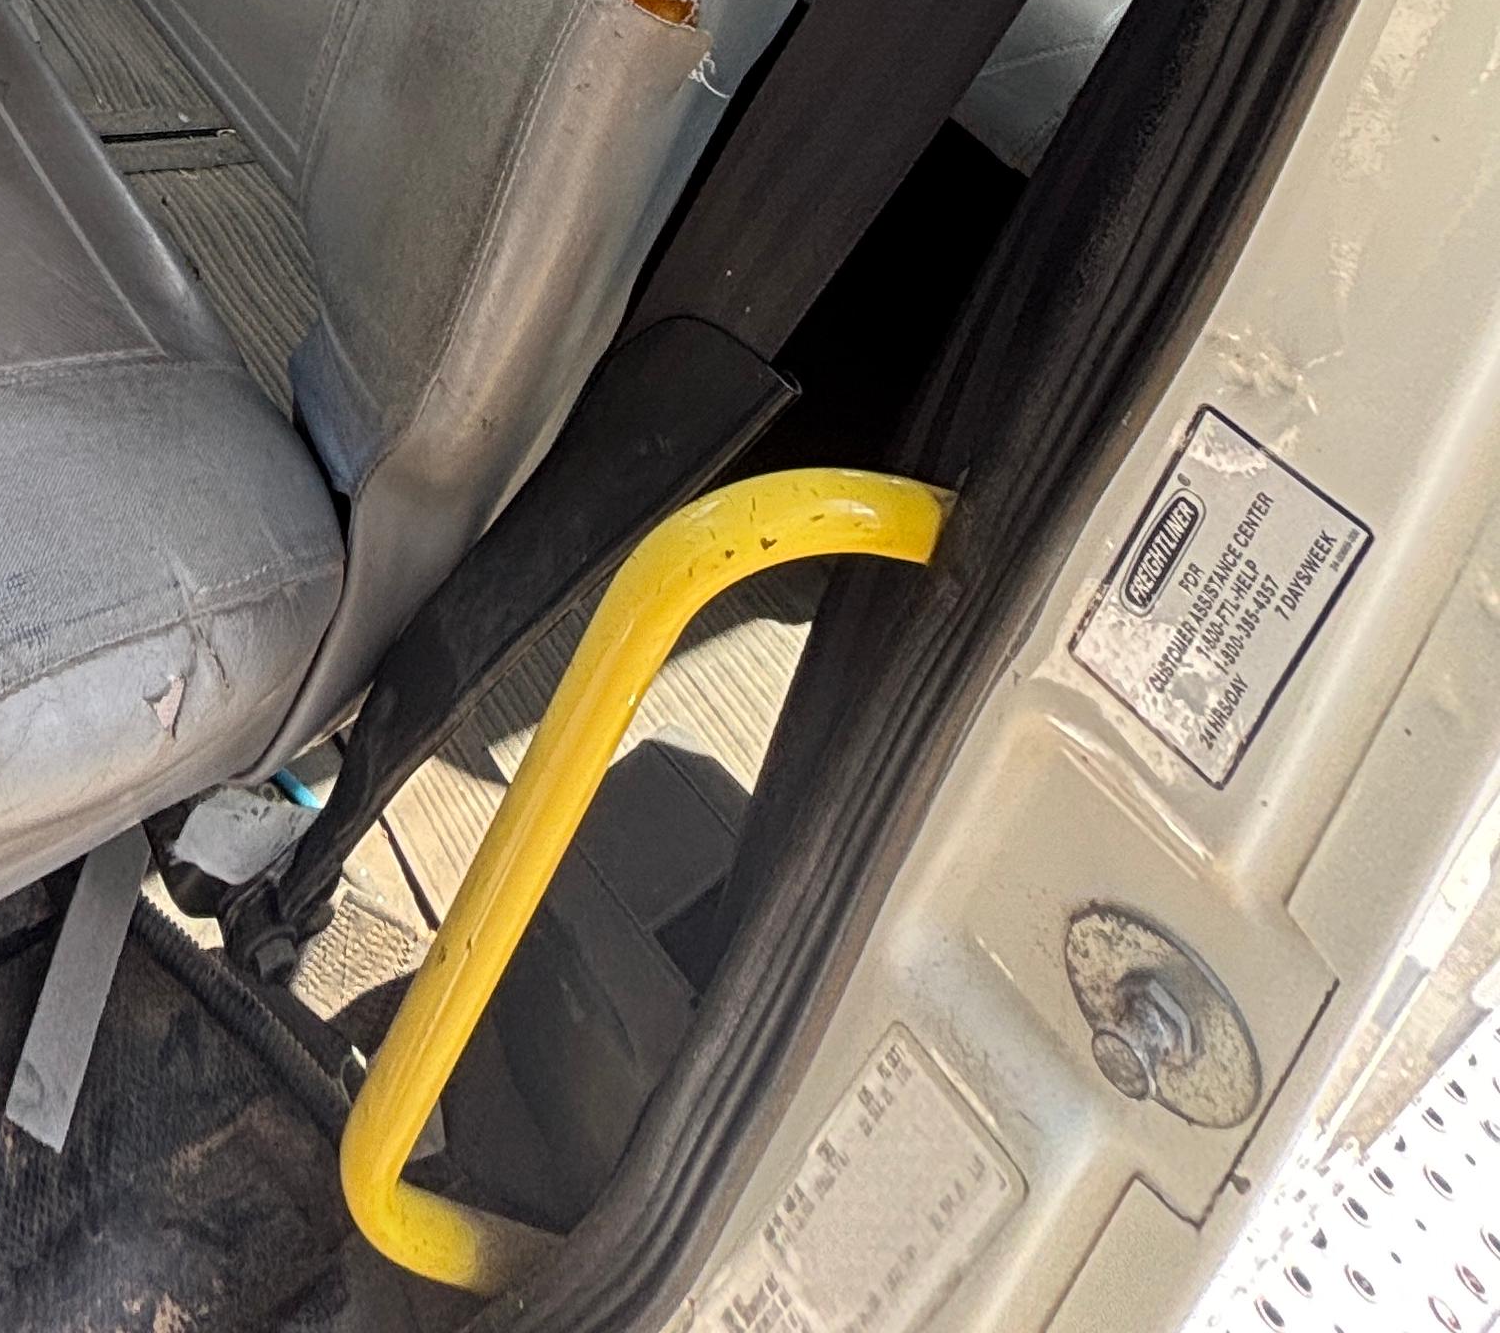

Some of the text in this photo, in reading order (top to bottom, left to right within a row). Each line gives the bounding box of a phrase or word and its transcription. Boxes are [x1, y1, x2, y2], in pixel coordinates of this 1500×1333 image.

[1129, 500, 1197, 607] FREIGHTLINER
[1149, 492, 1274, 694] CUSTOMER ASSISTANCE CENTER
[1179, 562, 1205, 596] FOR
[1274, 530, 1338, 621] 7 DAYS/WEEK
[1199, 673, 1249, 751] 24 HRS/DAY
